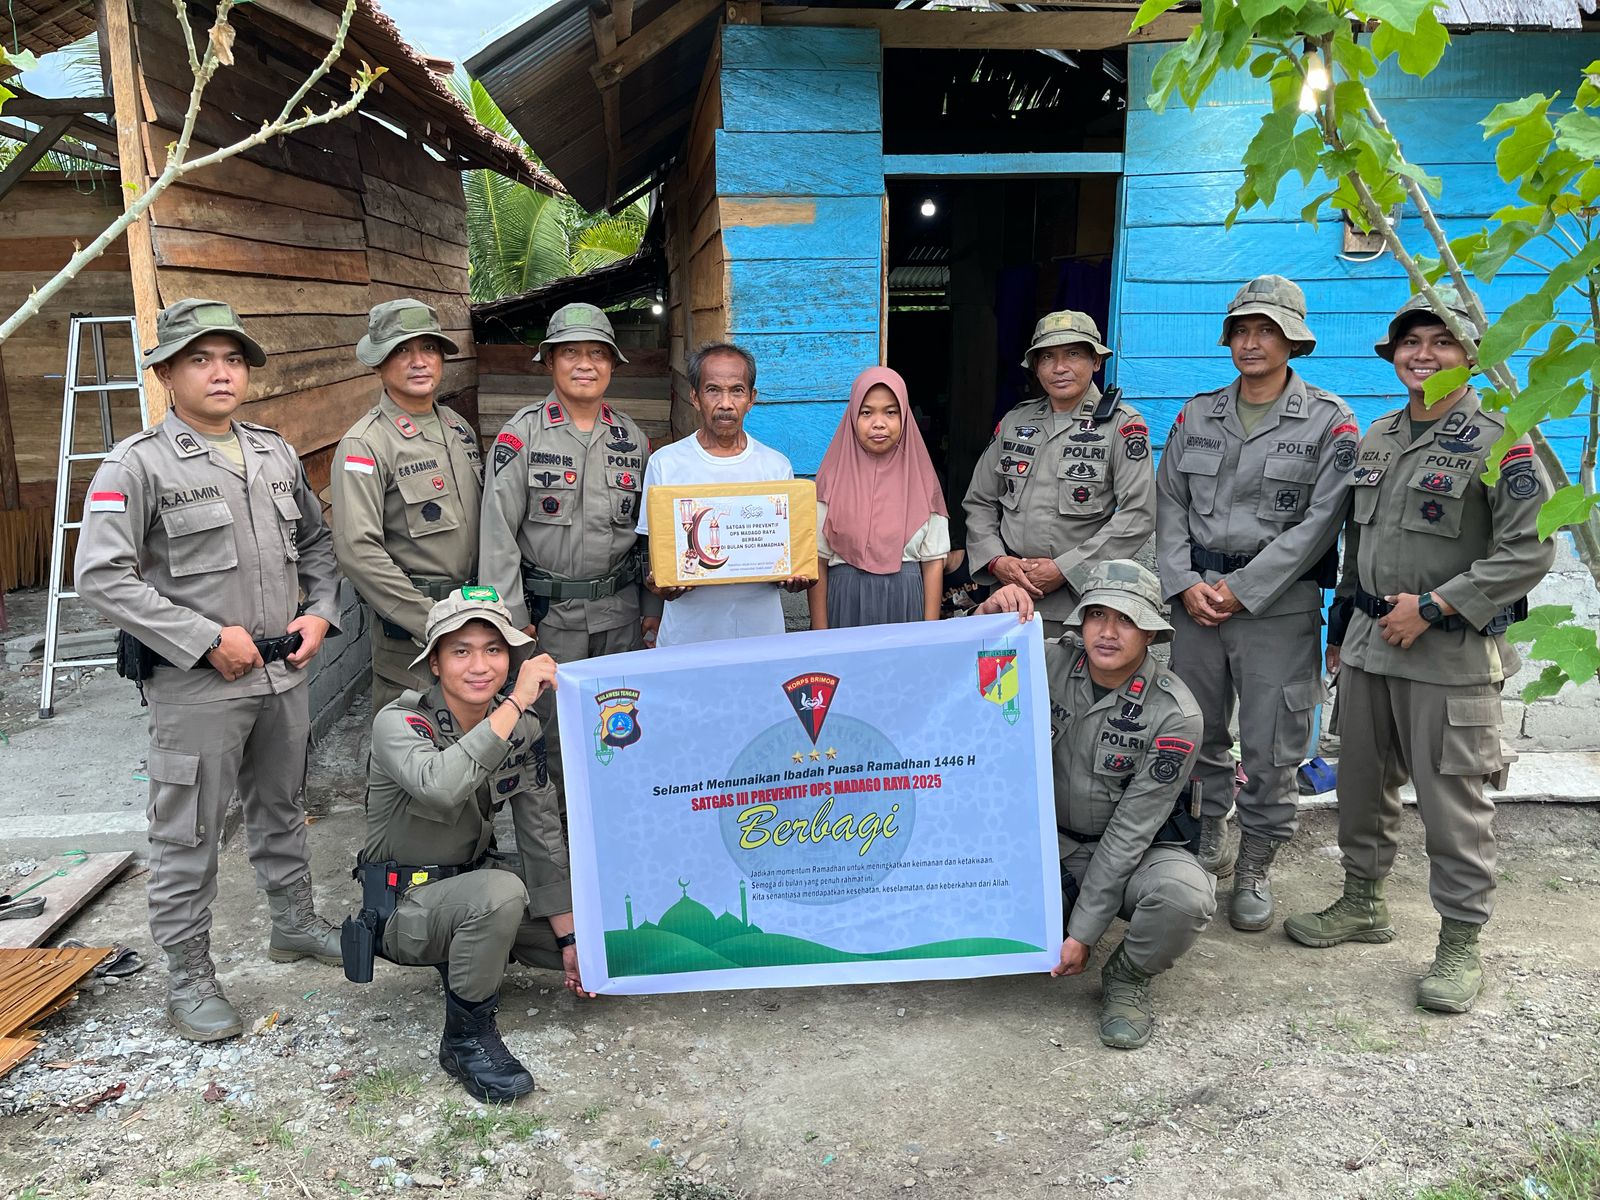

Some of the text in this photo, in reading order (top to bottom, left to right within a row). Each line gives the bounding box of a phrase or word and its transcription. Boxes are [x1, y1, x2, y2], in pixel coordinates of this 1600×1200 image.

[1063, 446, 1106, 460] POLRI
[1276, 442, 1318, 457] POLRI
[1383, 451, 1392, 462] S
[607, 455, 641, 469] POLRI
[1425, 455, 1473, 471] POLRI
[160, 485, 221, 509] A.ALIMIN
[787, 676, 836, 691] KORPS BRIMOB
[597, 691, 620, 703] SULAWESI
[1050, 703, 1071, 722] KY
[1101, 731, 1145, 750] POLRI
[500, 751, 526, 770] LRI
[652, 755, 976, 796] Selamat Menunaikan Ibadah Puasa Ramadhan 1446 H
[691, 774, 942, 811] SATGAS III PREVENTIF OPS MADAGO RAYA 2025
[736, 796, 900, 857] Berbagi
[776, 868, 810, 876] momentum
[812, 865, 846, 873] Ramadhan
[867, 861, 911, 870] meningkatkan
[912, 859, 943, 868] keimanan
[944, 858, 957, 866] dan
[751, 881, 776, 890] Semoga
[803, 879, 819, 887] yang
[820, 877, 840, 885] penuh
[841, 875, 864, 883] rahmat
[752, 892, 765, 900] Kita
[766, 891, 801, 900] senantiasa
[802, 889, 845, 898] mendapatkan
[926, 882, 938, 890] dan
[940, 881, 977, 889] keberkahan
